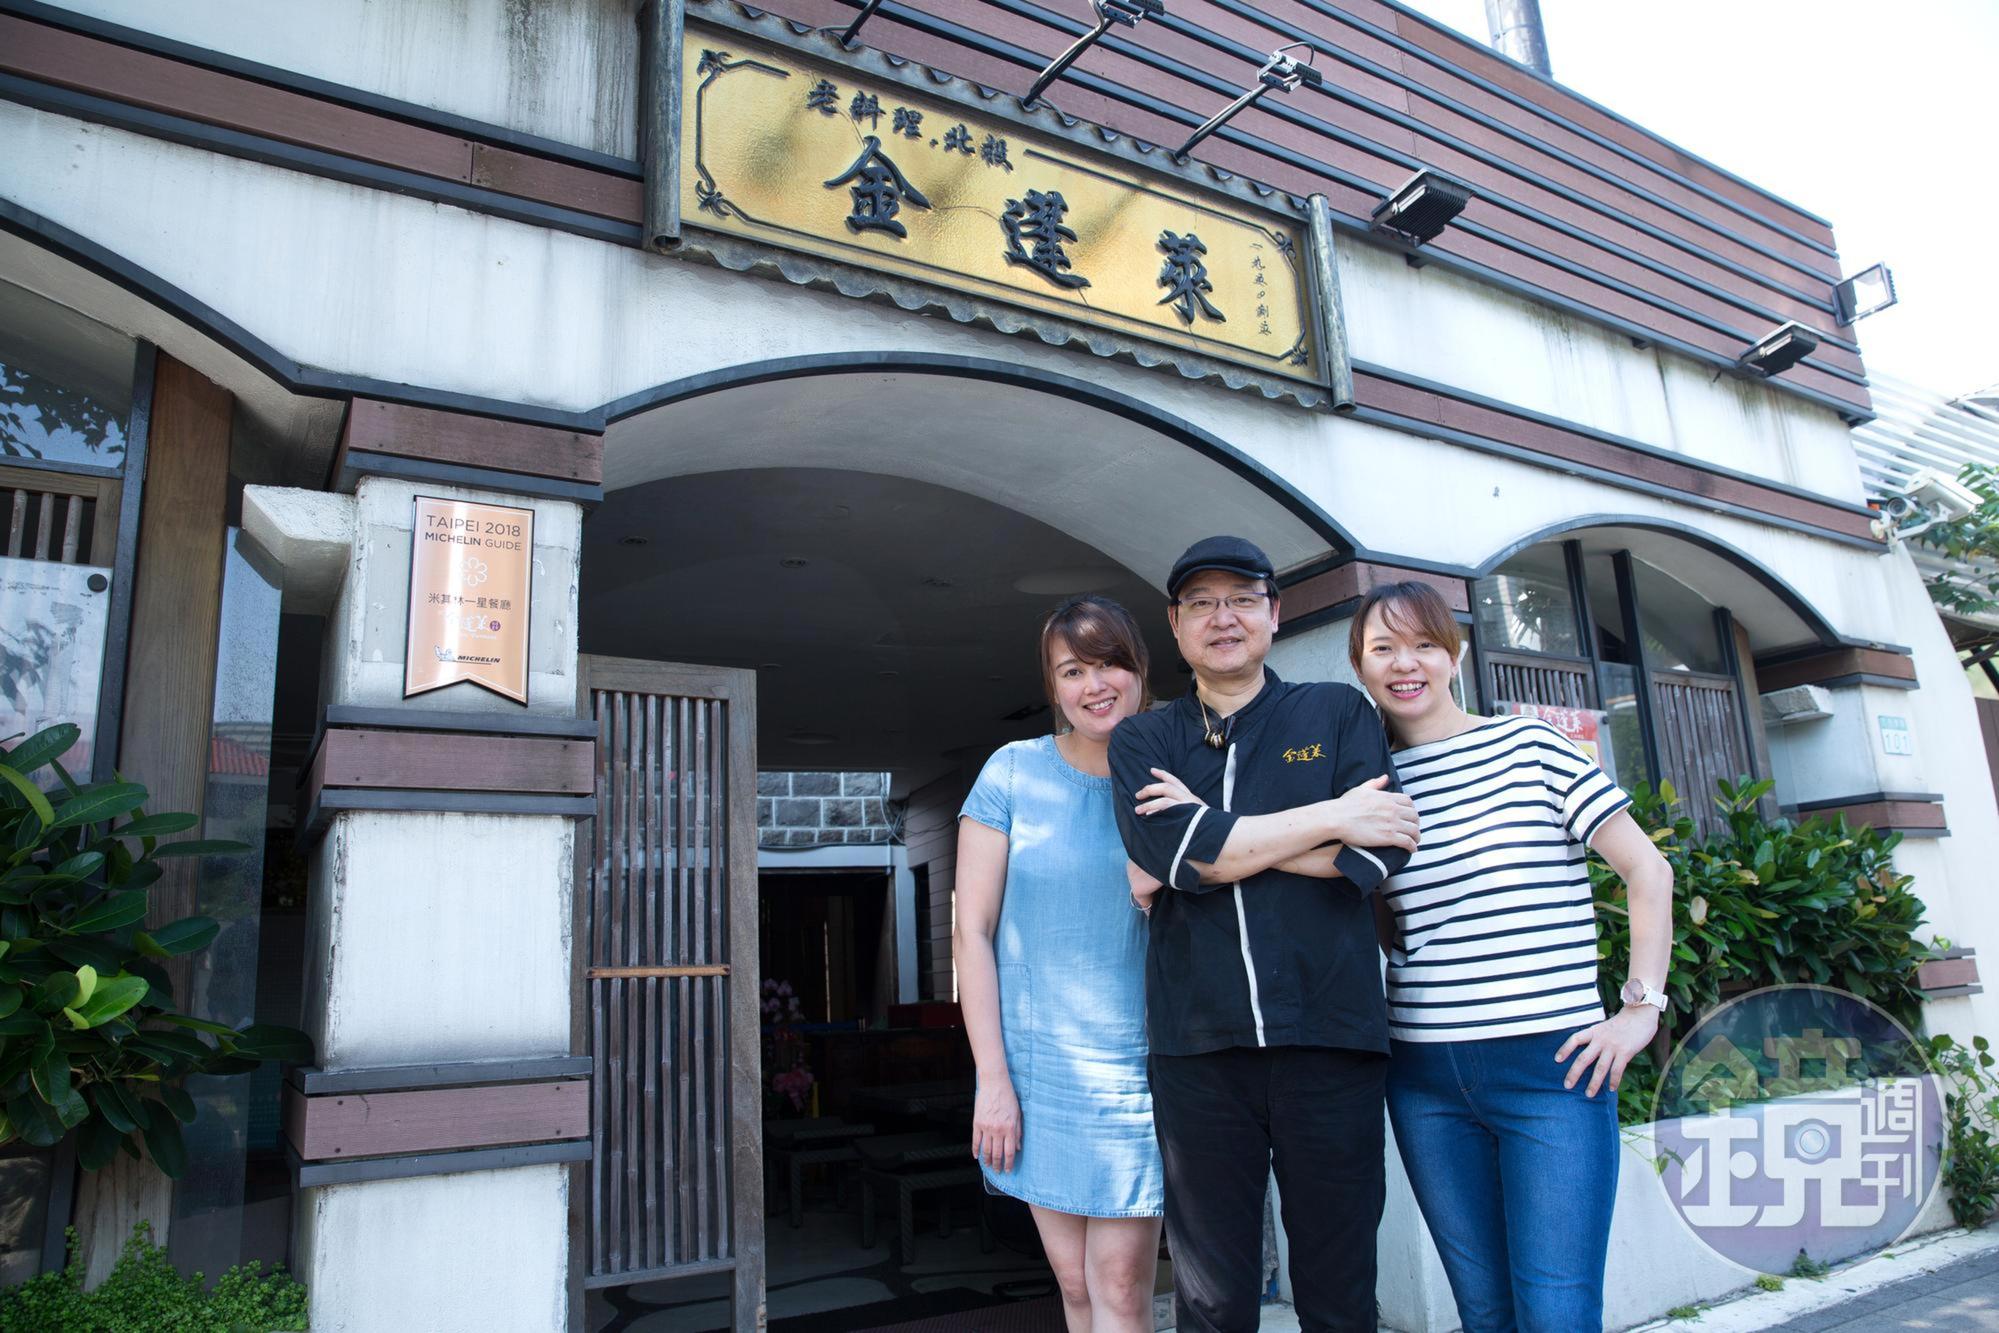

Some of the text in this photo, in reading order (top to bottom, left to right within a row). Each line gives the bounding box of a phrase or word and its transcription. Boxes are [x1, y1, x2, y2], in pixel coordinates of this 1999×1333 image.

[824, 135, 1227, 324] 金蓬萊
[426, 514, 521, 537] TAIPEI 2018
[425, 532, 521, 551] MICHELIN GUIDE
[457, 655, 501, 663] MICHELIN
